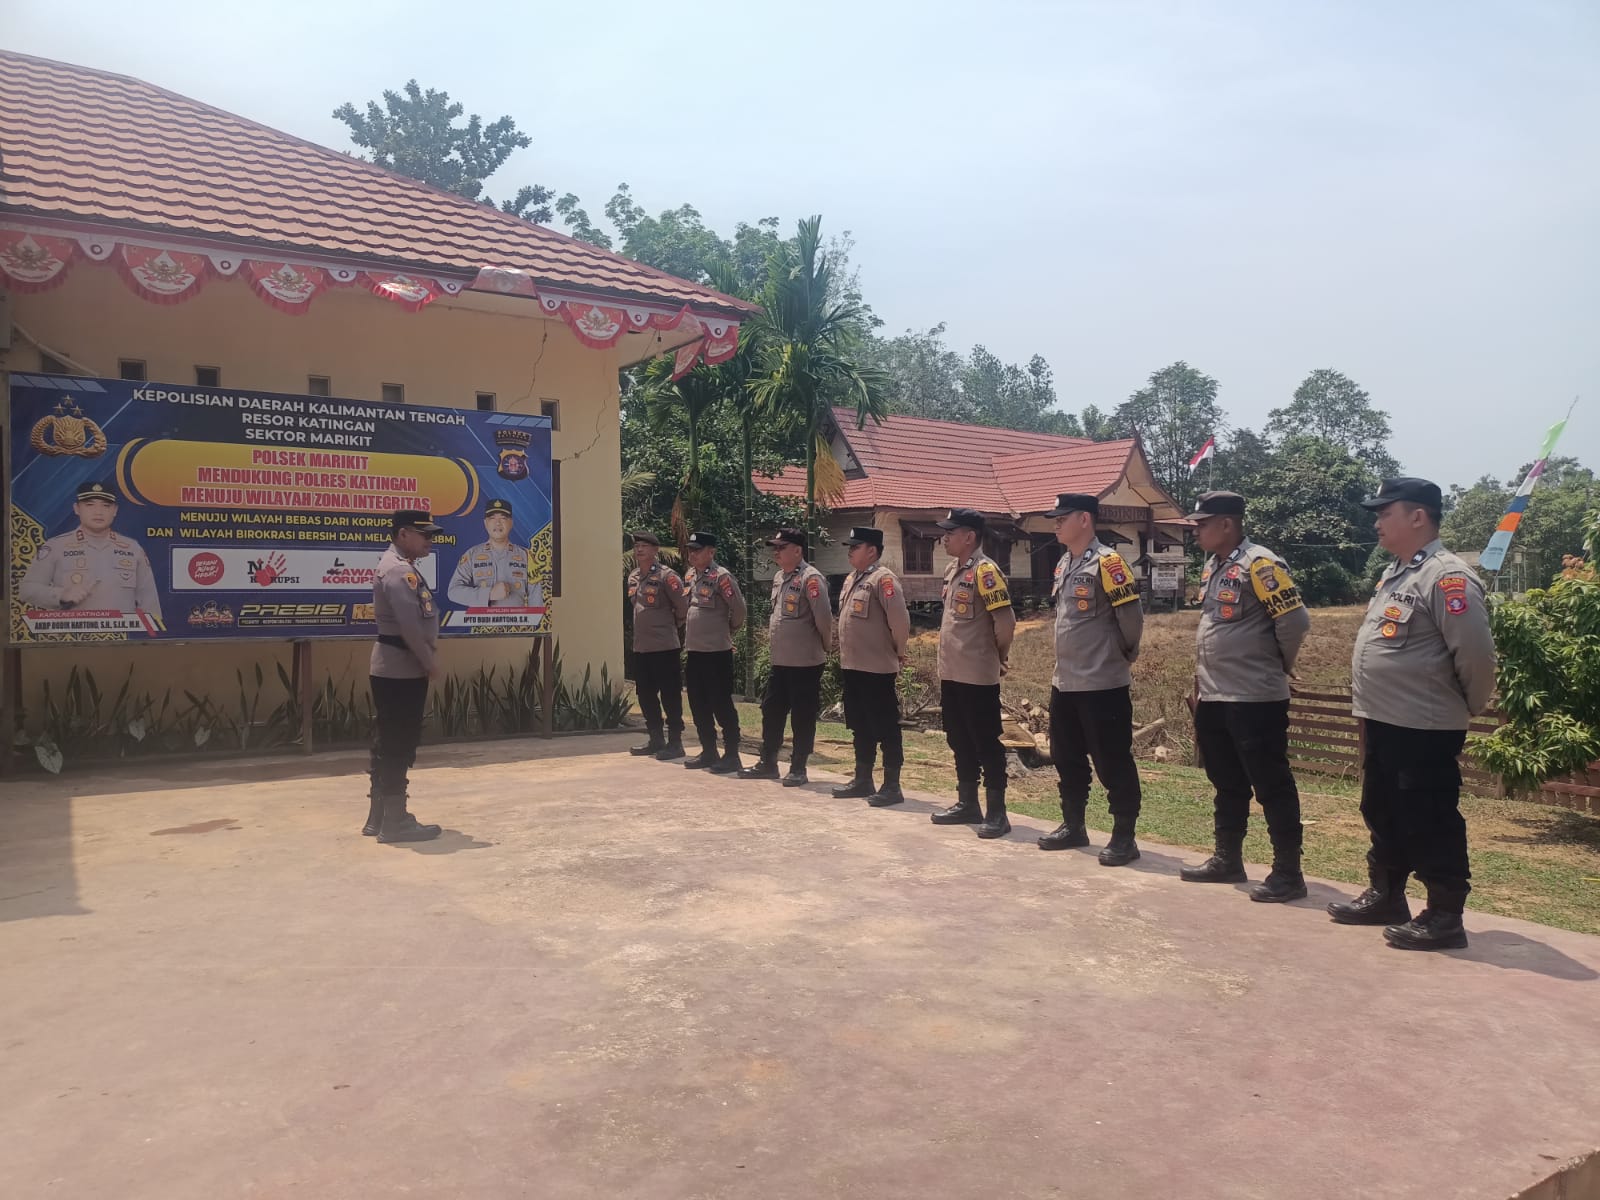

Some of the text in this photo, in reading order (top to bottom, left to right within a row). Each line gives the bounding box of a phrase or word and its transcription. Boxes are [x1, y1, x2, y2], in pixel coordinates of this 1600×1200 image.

[133, 388, 465, 426] KEPOLISIAN DAERAH KALIMANTAN TENGAH
[241, 413, 375, 433] RESOR KATINGAN
[245, 428, 372, 447] SEKTOR MARIKIT
[252, 449, 369, 470] POLSEK MARIKIT
[198, 467, 417, 491] MENDUKUNG POLRES KATINGAN
[181, 487, 430, 511] MENUJU WILAYAH ZONA INTEGRITAS
[180, 512, 393, 528] MENUJU WILAYAH BEBAS DARI KORUPS
[147, 527, 174, 538] DAN
[180, 528, 233, 540] WILAYAH
[236, 530, 296, 541] BIROKRASI
[298, 531, 337, 542] BERSIH
[339, 533, 363, 543] DAN
[365, 534, 393, 544] MELA
[250, 576, 300, 584] KRUPSI
[322, 576, 374, 585] KORUPS
[1389, 591, 1415, 605] POLRI
